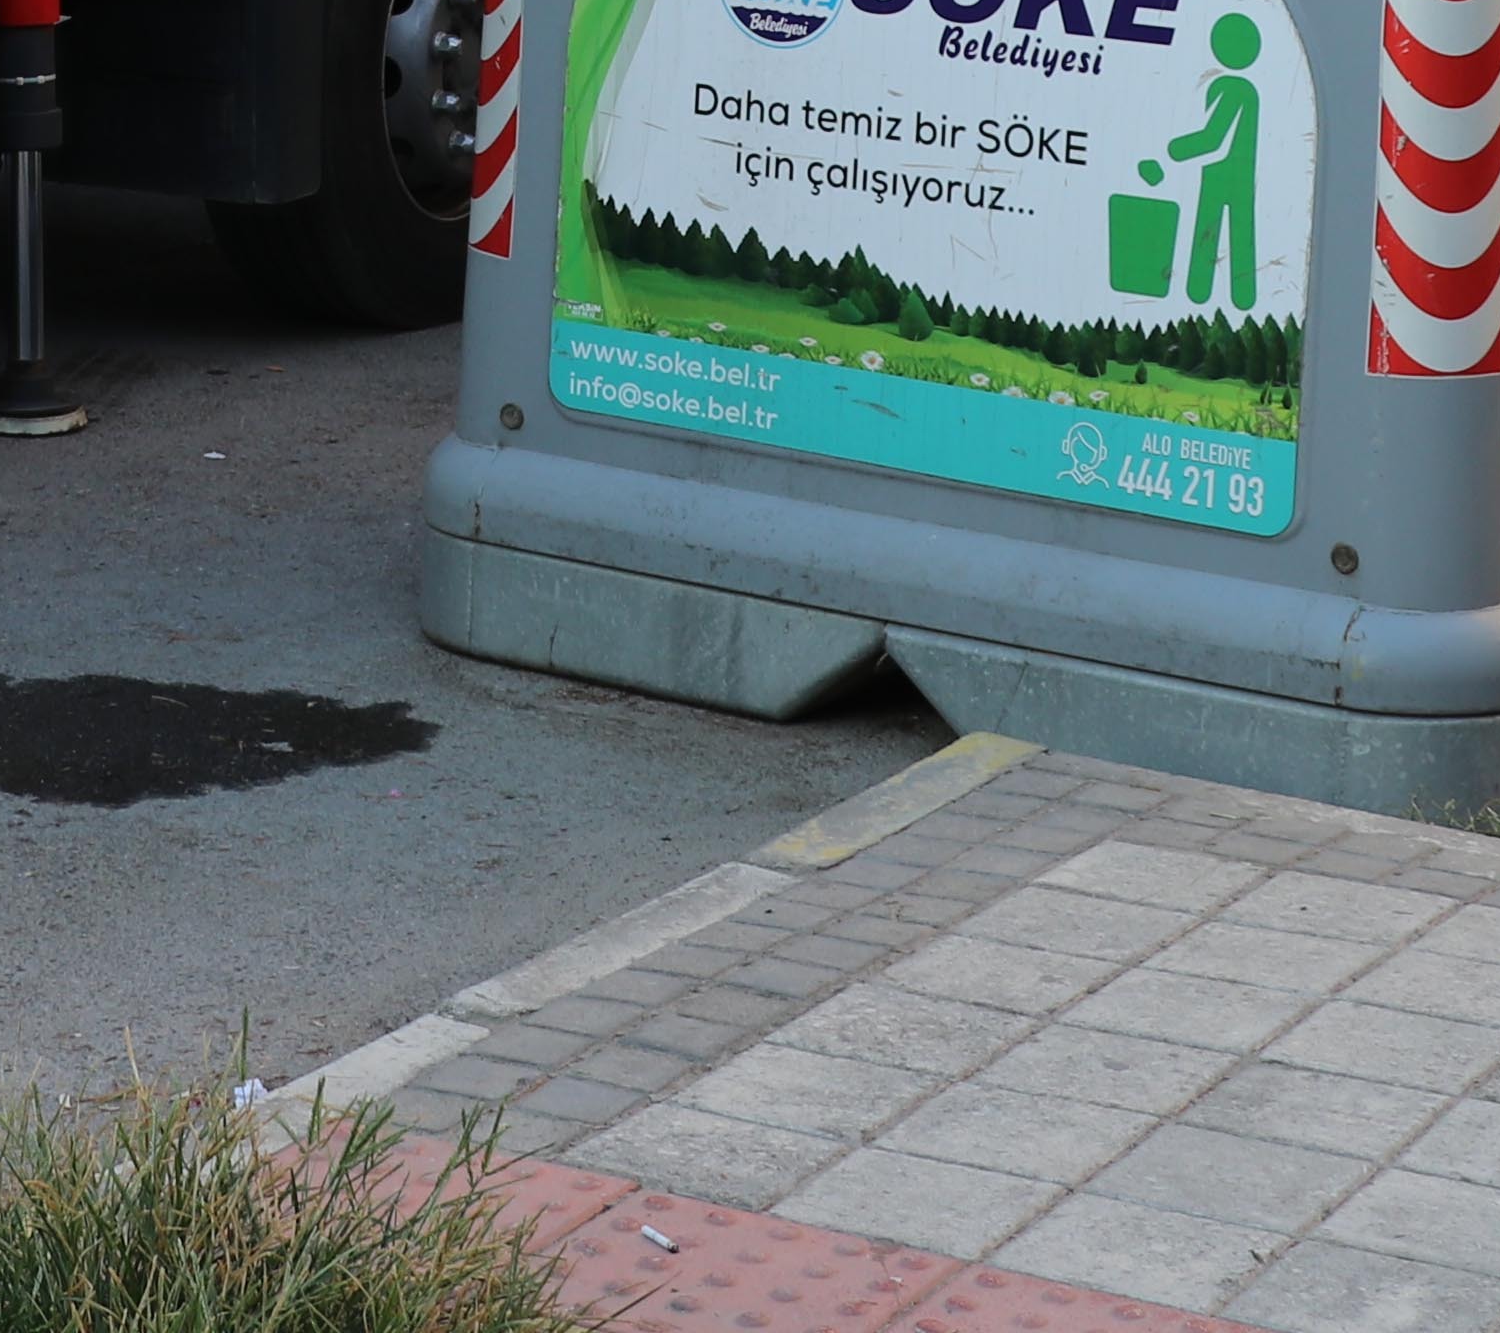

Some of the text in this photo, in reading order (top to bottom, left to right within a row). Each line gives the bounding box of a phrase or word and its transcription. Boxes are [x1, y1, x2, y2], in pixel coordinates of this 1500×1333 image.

[749, 13, 809, 38] Belediyesi
[938, 25, 1104, 78] Belediyesi
[693, 82, 1089, 166] Daha temiz bir SÖKE
[735, 142, 1035, 216] için çalışıyoruz...
[570, 339, 782, 393] www.soke.bel.tr
[569, 371, 779, 431] info@soke.bel.tr
[1141, 432, 1172, 456] ALO
[1117, 455, 1265, 517] 444 21 93
